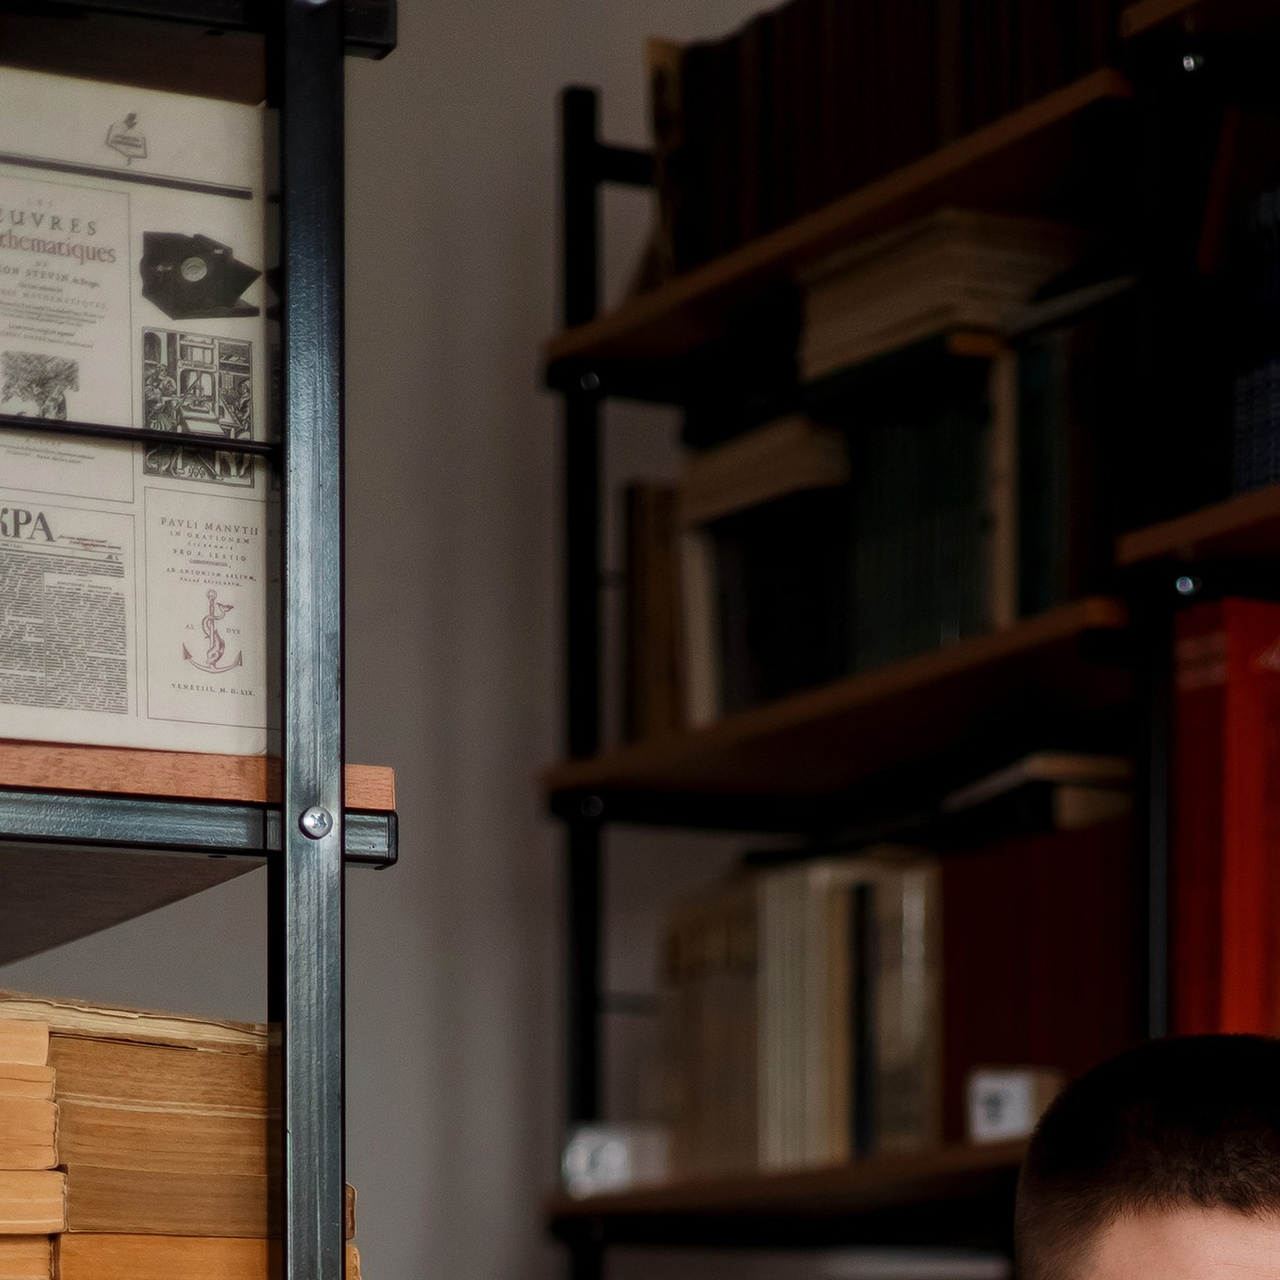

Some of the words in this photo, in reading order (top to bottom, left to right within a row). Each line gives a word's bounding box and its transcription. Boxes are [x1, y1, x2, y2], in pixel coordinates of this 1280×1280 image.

[0, 208, 96, 236] UVRES
[160, 517, 198, 530] PAVLI
[205, 522, 258, 536] MANVTII
[187, 533, 250, 544] ORATIONEM
